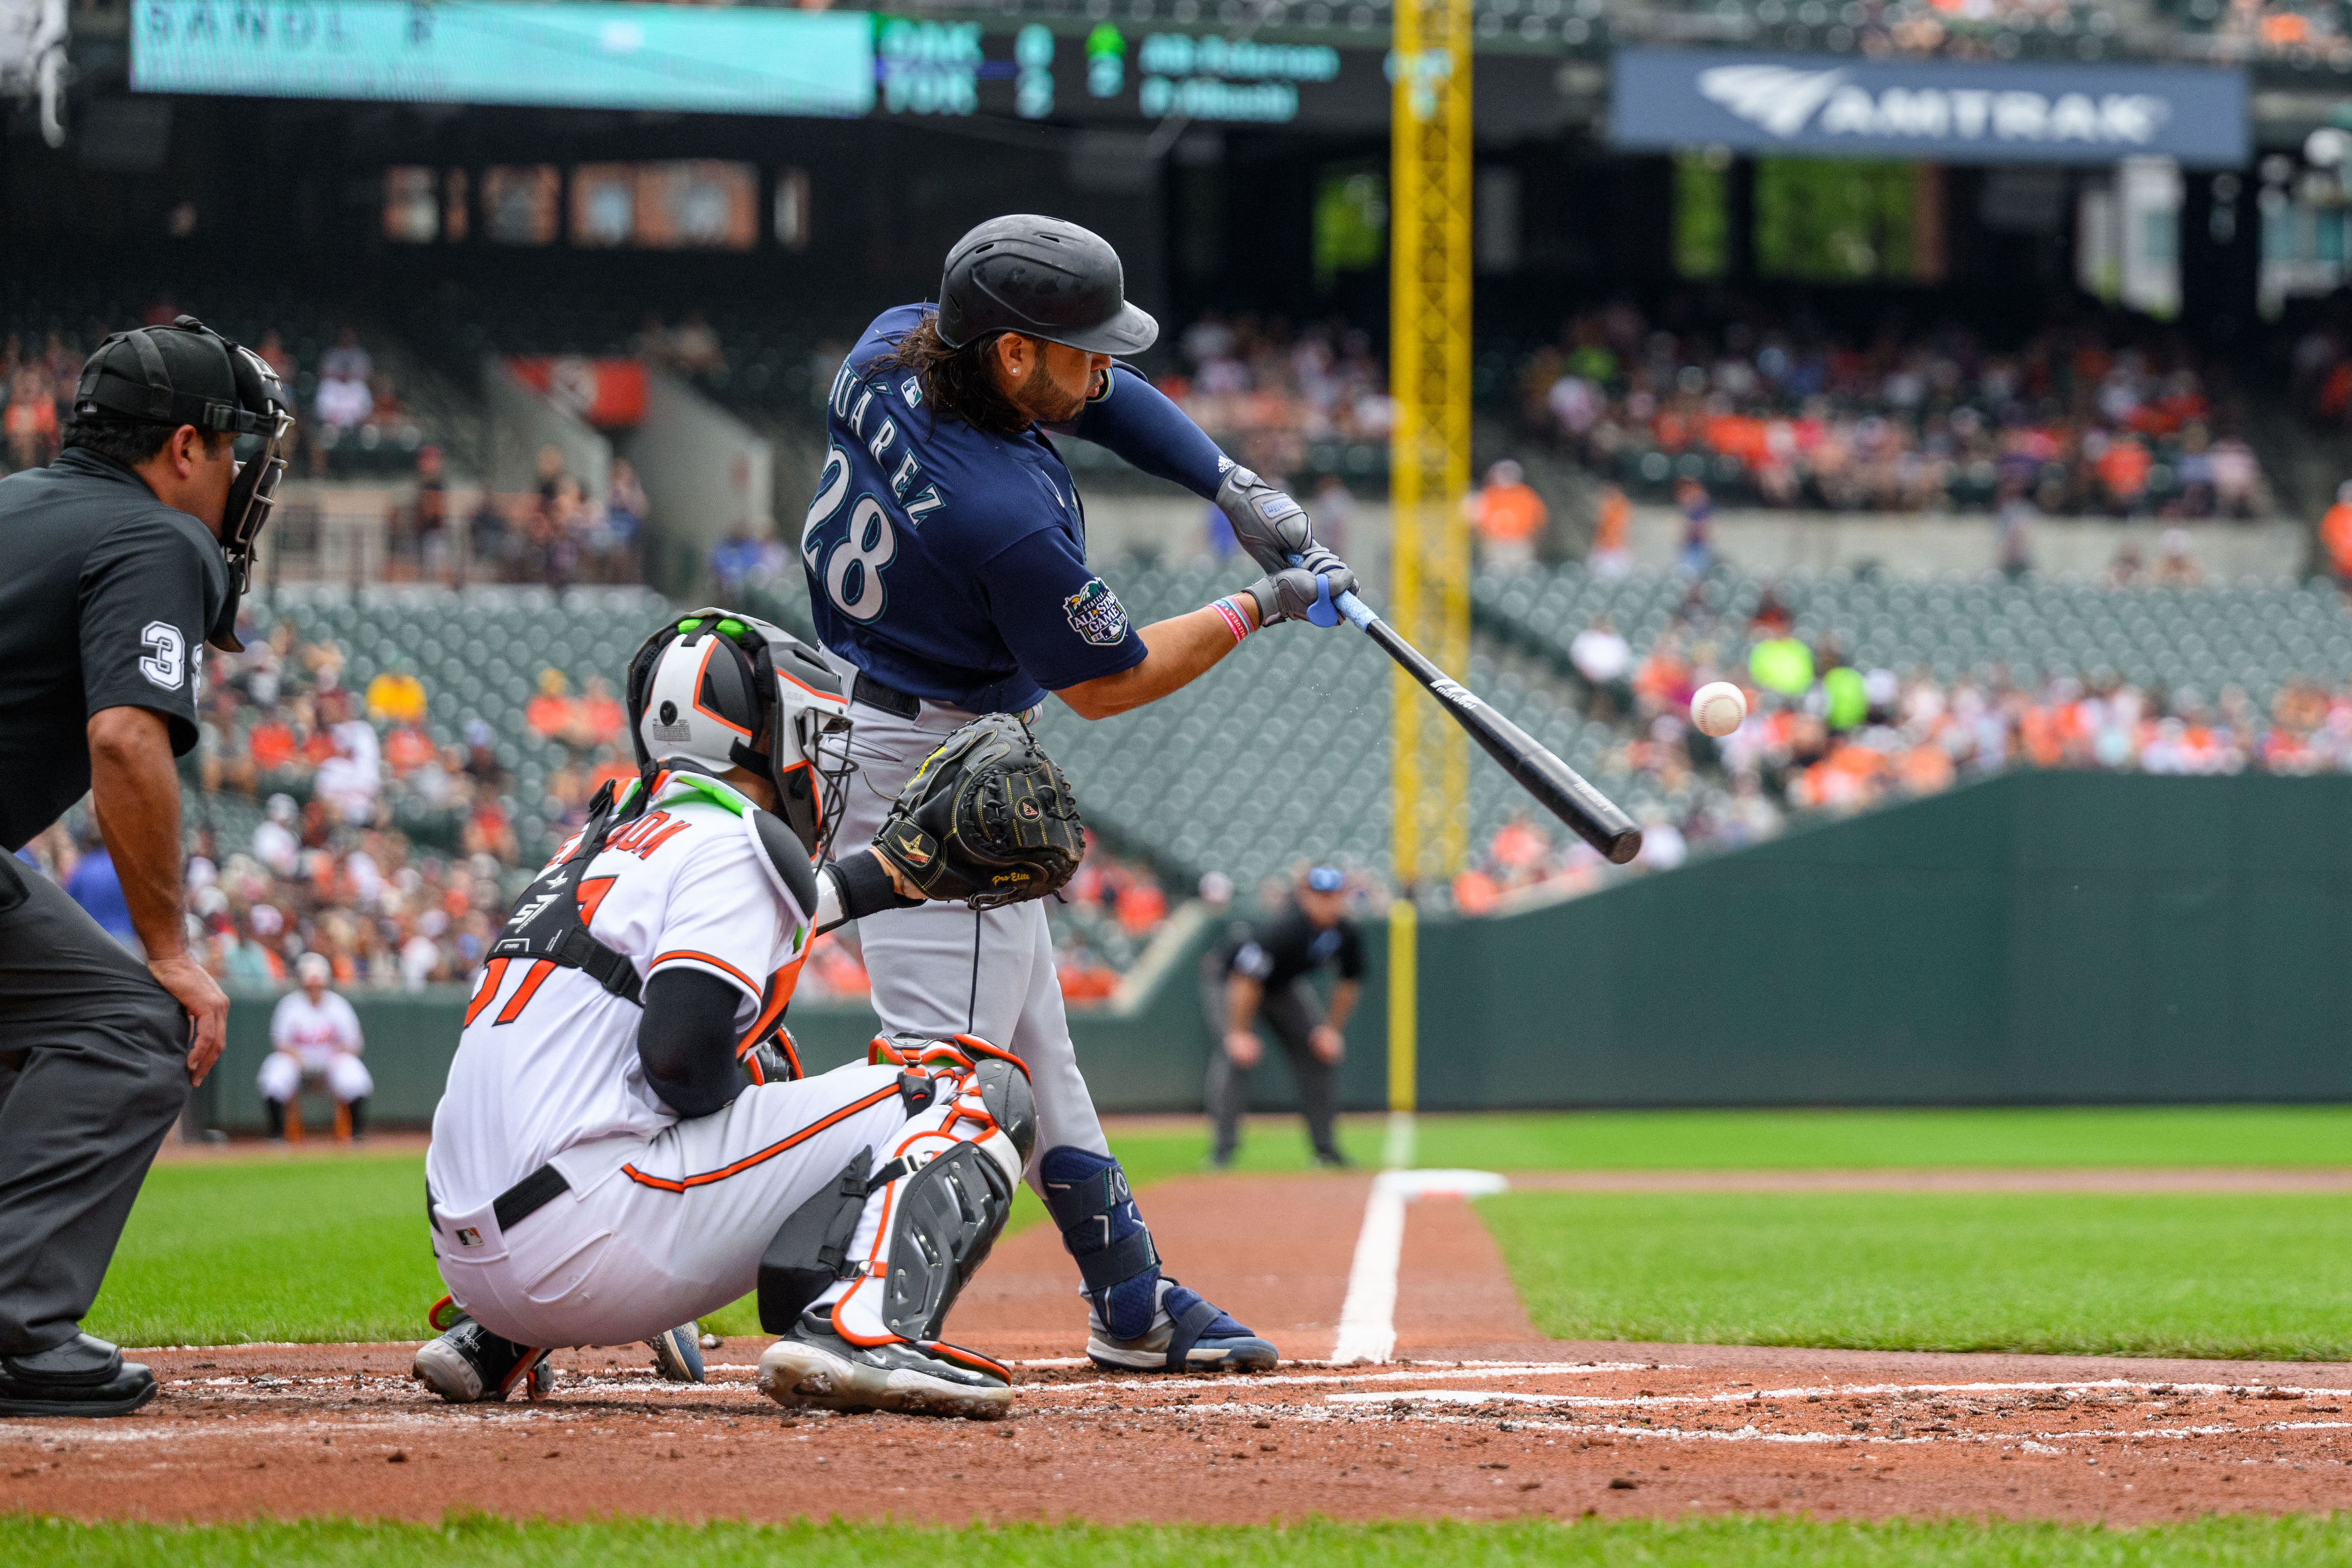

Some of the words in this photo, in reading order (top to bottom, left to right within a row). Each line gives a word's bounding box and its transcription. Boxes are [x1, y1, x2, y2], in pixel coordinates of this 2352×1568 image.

[1821, 86, 2153, 142] AMTRAK
[828, 356, 946, 530] UÁREZ
[802, 433, 898, 626] 28
[1083, 591, 1104, 612] SEATTLE
[1088, 604, 1120, 632] GAME
[992, 872, 1030, 887] Pro-Elite
